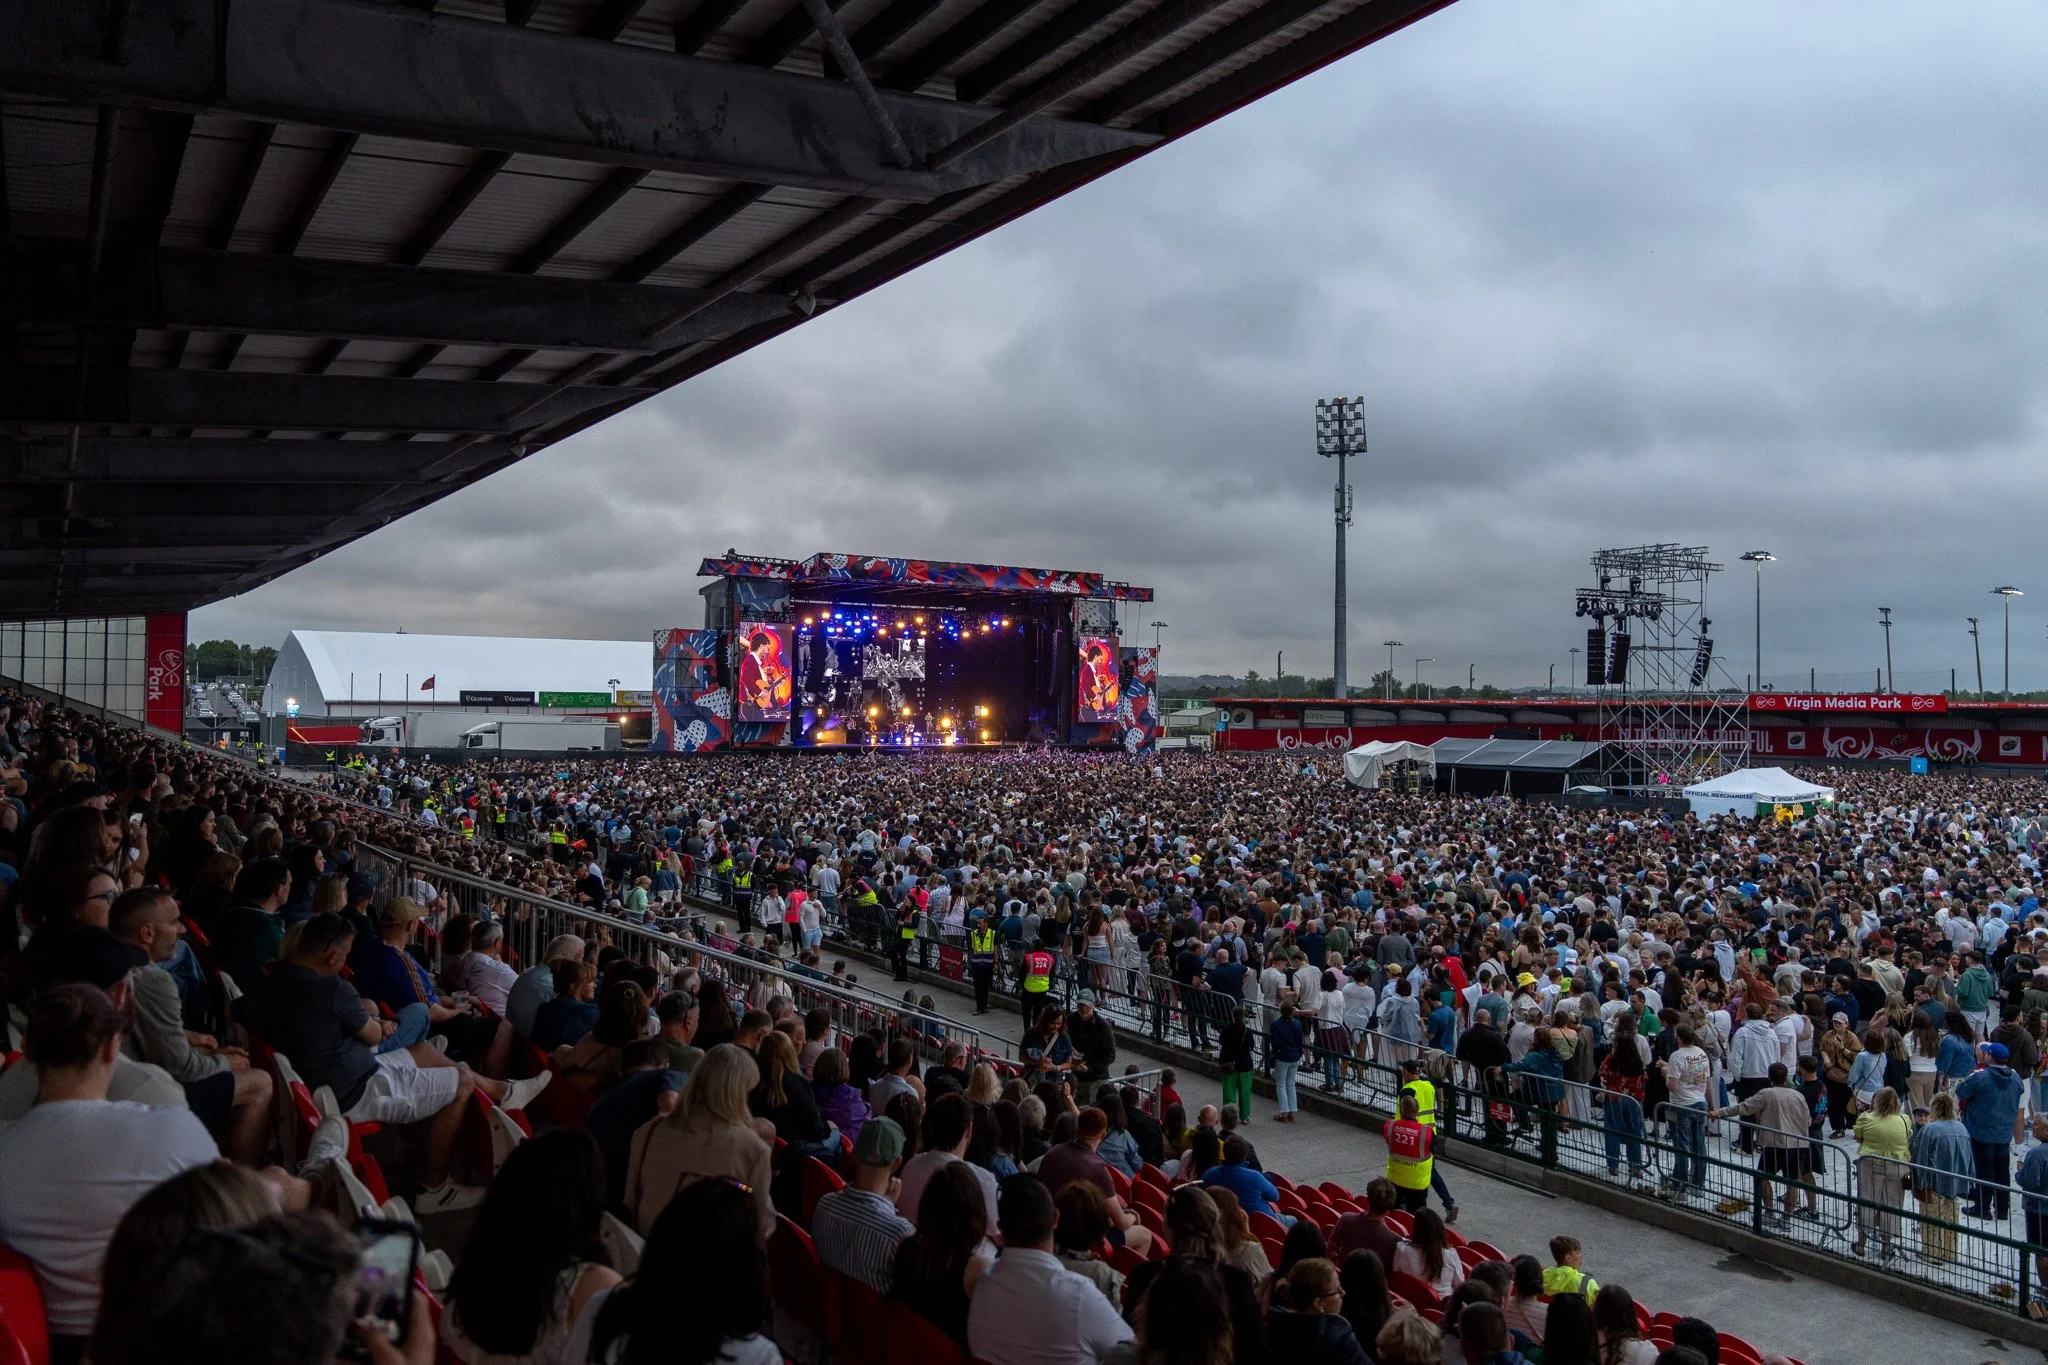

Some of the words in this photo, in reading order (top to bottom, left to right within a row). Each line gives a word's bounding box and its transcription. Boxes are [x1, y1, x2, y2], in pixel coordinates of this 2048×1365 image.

[149, 667, 163, 700] Park
[1784, 696, 1822, 711] Virgin
[1824, 696, 1867, 708] Media
[1870, 696, 1902, 708] Park
[1221, 710, 1230, 722] D
[1684, 790, 1710, 798] OFFICIAL
[1711, 792, 1754, 800] MERCHANDISE
[1395, 1133, 1415, 1146] 221
